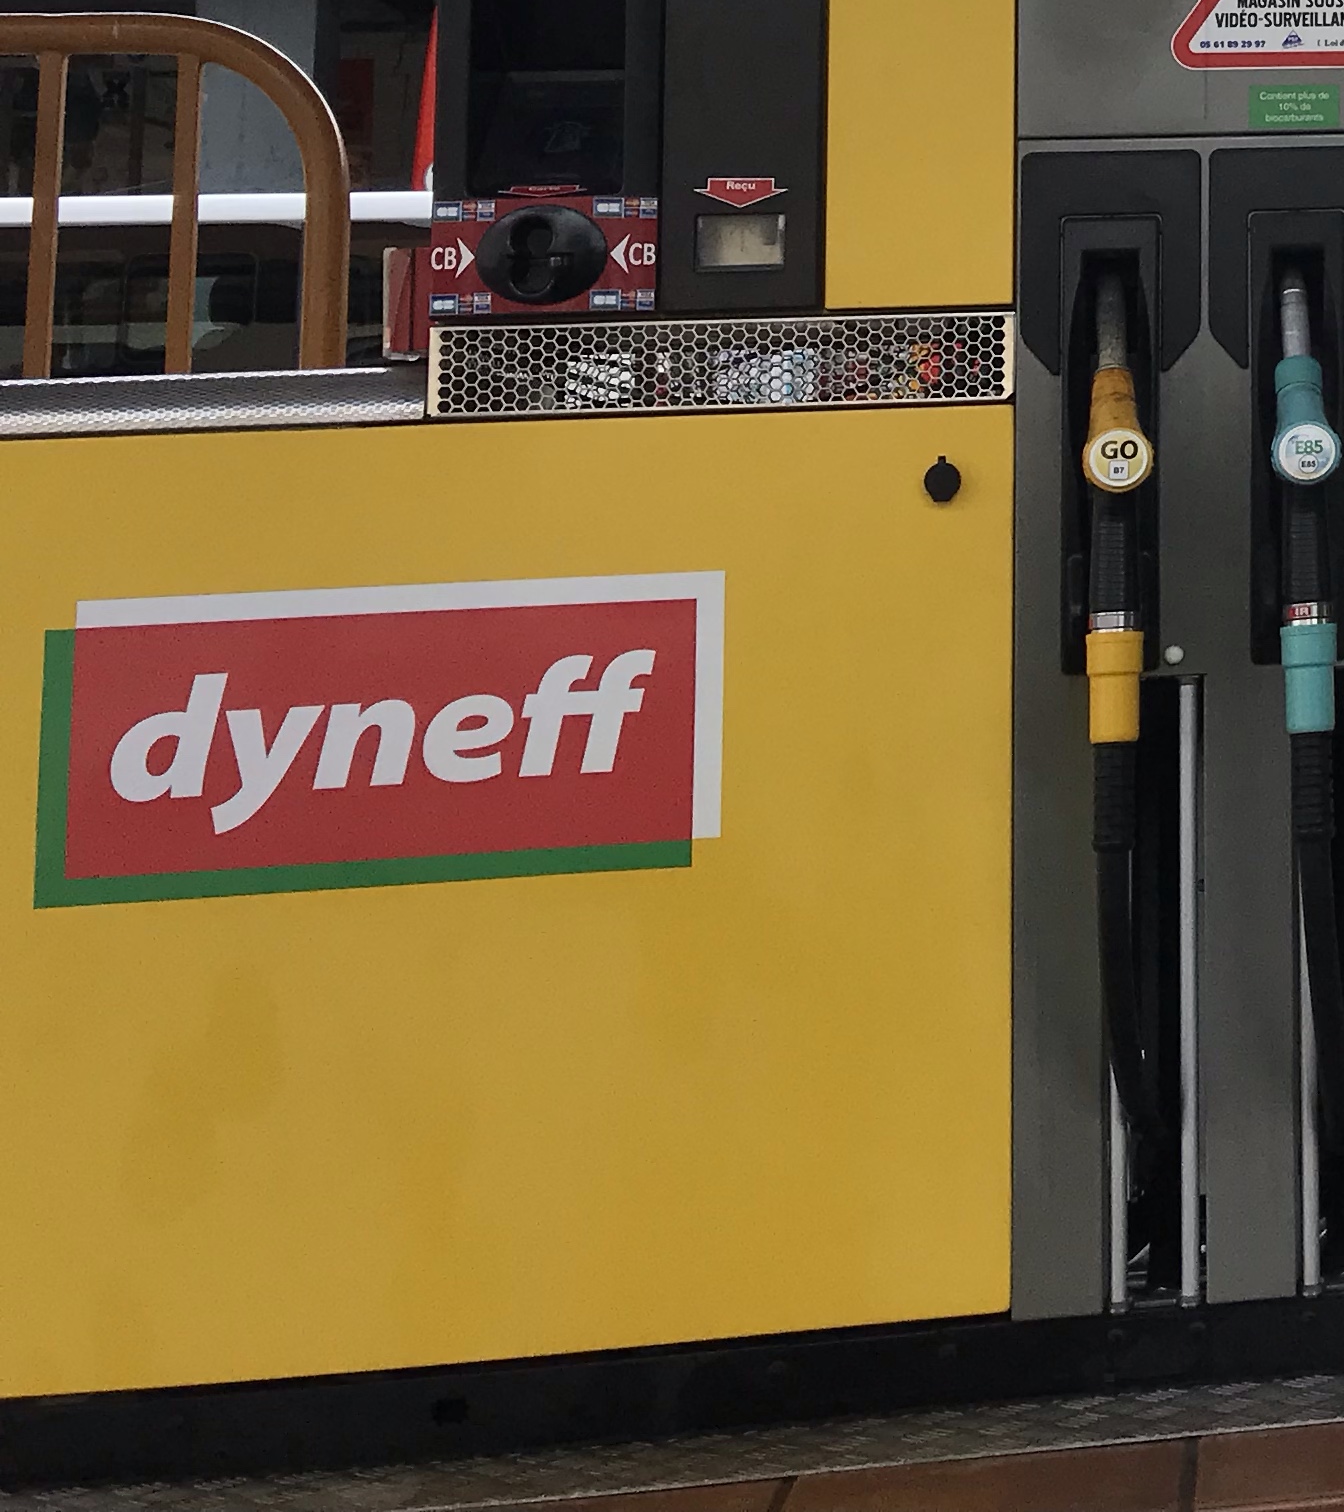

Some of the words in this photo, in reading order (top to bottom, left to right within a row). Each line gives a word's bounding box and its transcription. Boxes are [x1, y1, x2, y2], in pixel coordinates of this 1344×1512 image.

[1259, 91, 1296, 100] Contient
[1298, 91, 1316, 102] plus
[1265, 113, 1324, 122] biocarburants
[726, 181, 756, 192] Reçu
[431, 247, 457, 270] CB
[628, 243, 656, 266] CB
[1100, 440, 1139, 460] GO
[1294, 439, 1323, 456] E85
[1113, 466, 1125, 475] B7
[110, 649, 656, 835] dyneff
